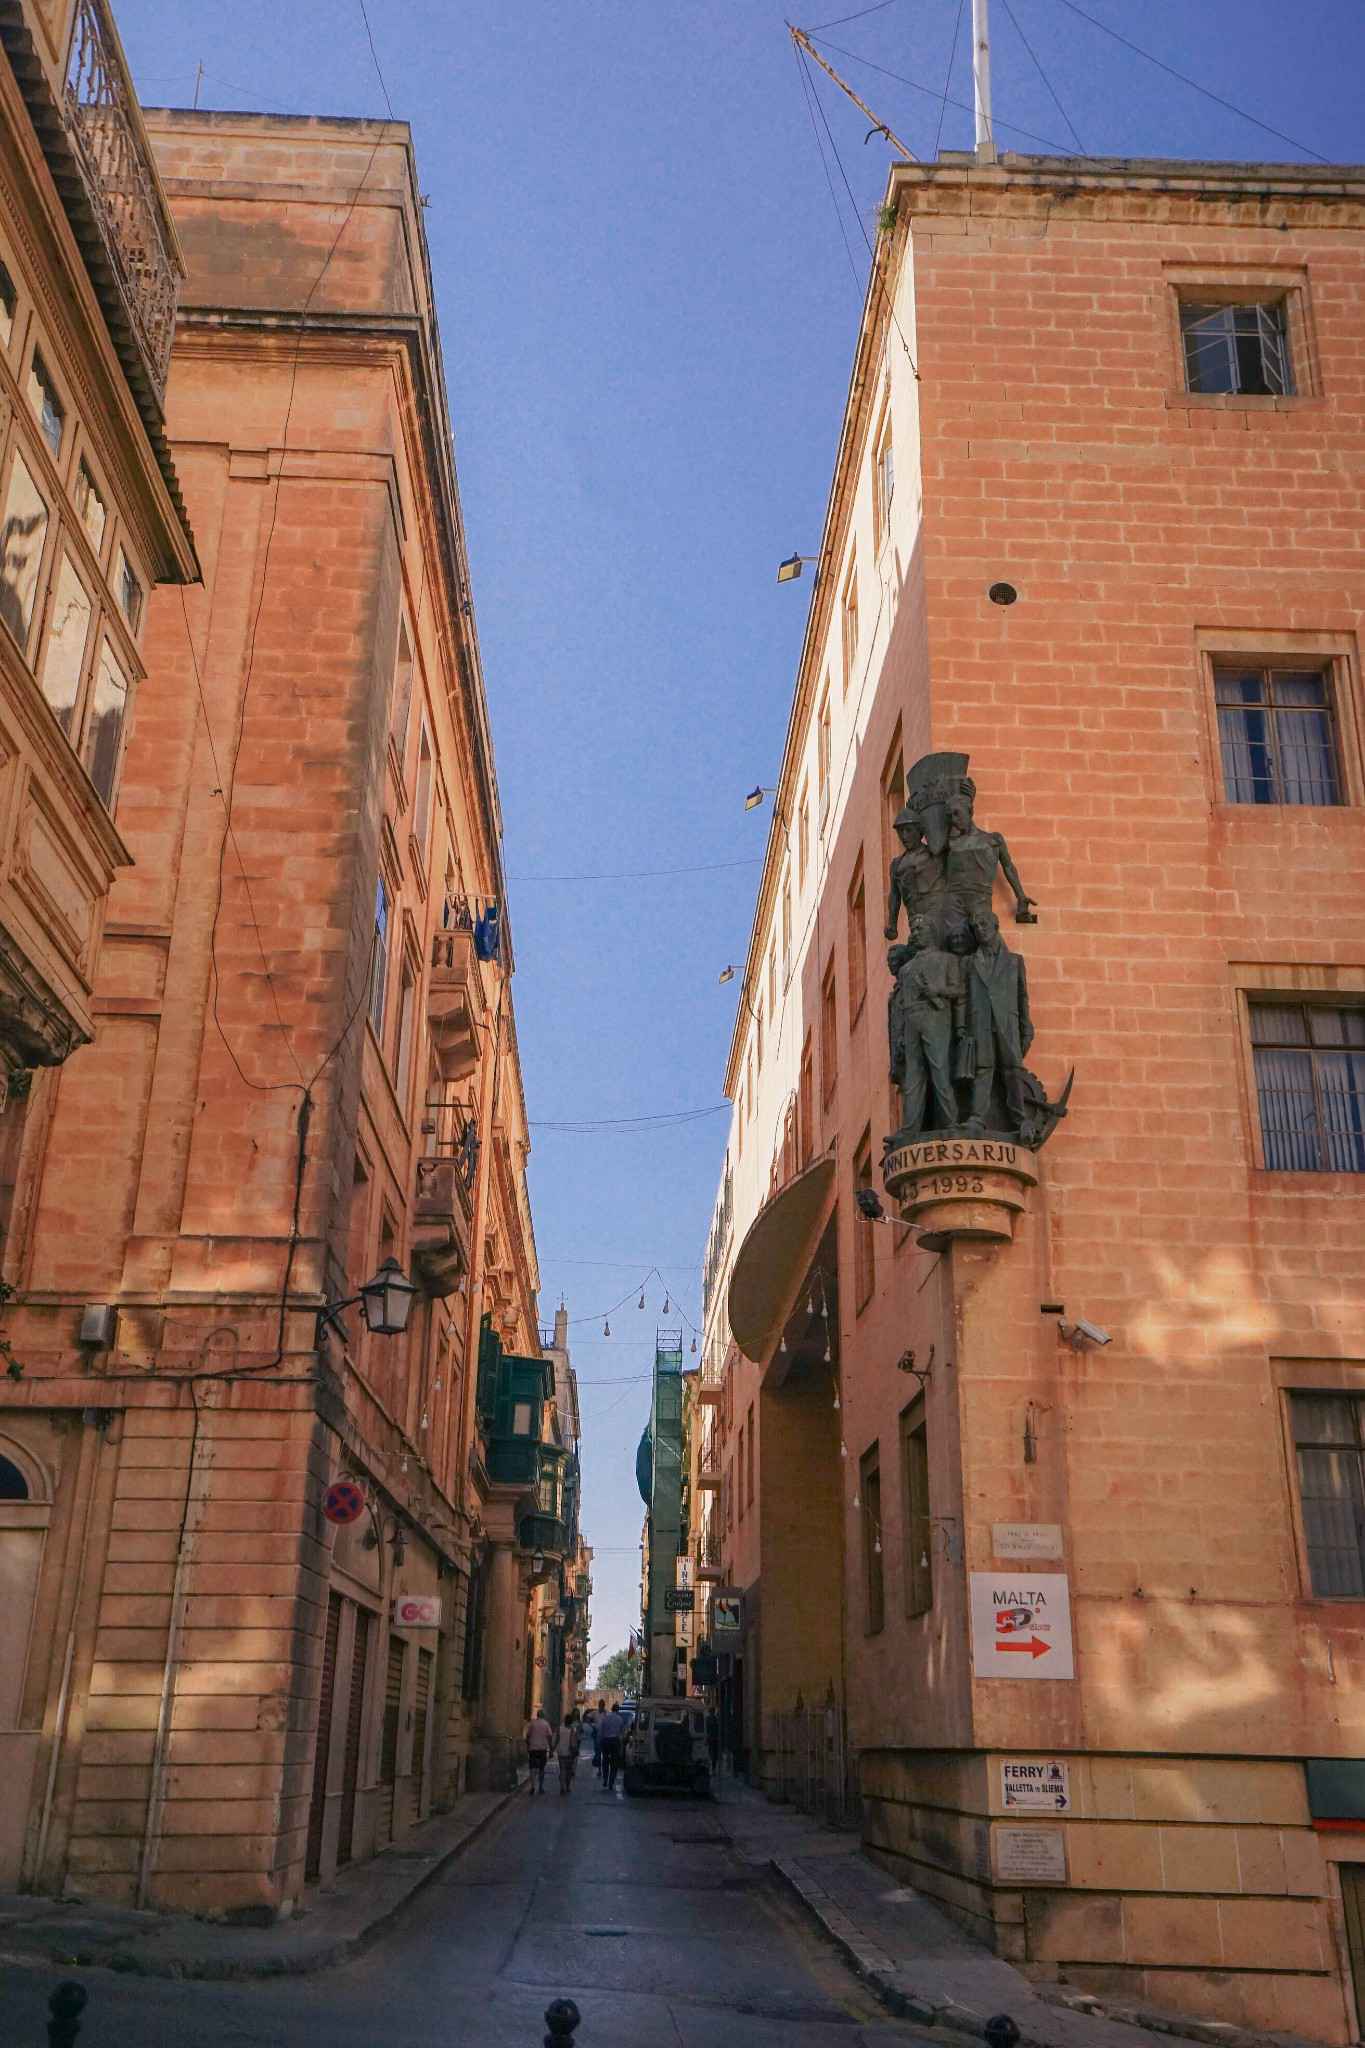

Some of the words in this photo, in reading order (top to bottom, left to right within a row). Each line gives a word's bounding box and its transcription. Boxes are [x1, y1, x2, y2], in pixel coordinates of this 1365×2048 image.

[993, 1591, 1047, 1605] MALTA
[1004, 1766, 1044, 1778] FERRY
[1005, 1784, 1033, 1793] VALLETTA
[1041, 1784, 1064, 1793] SLIEMA
